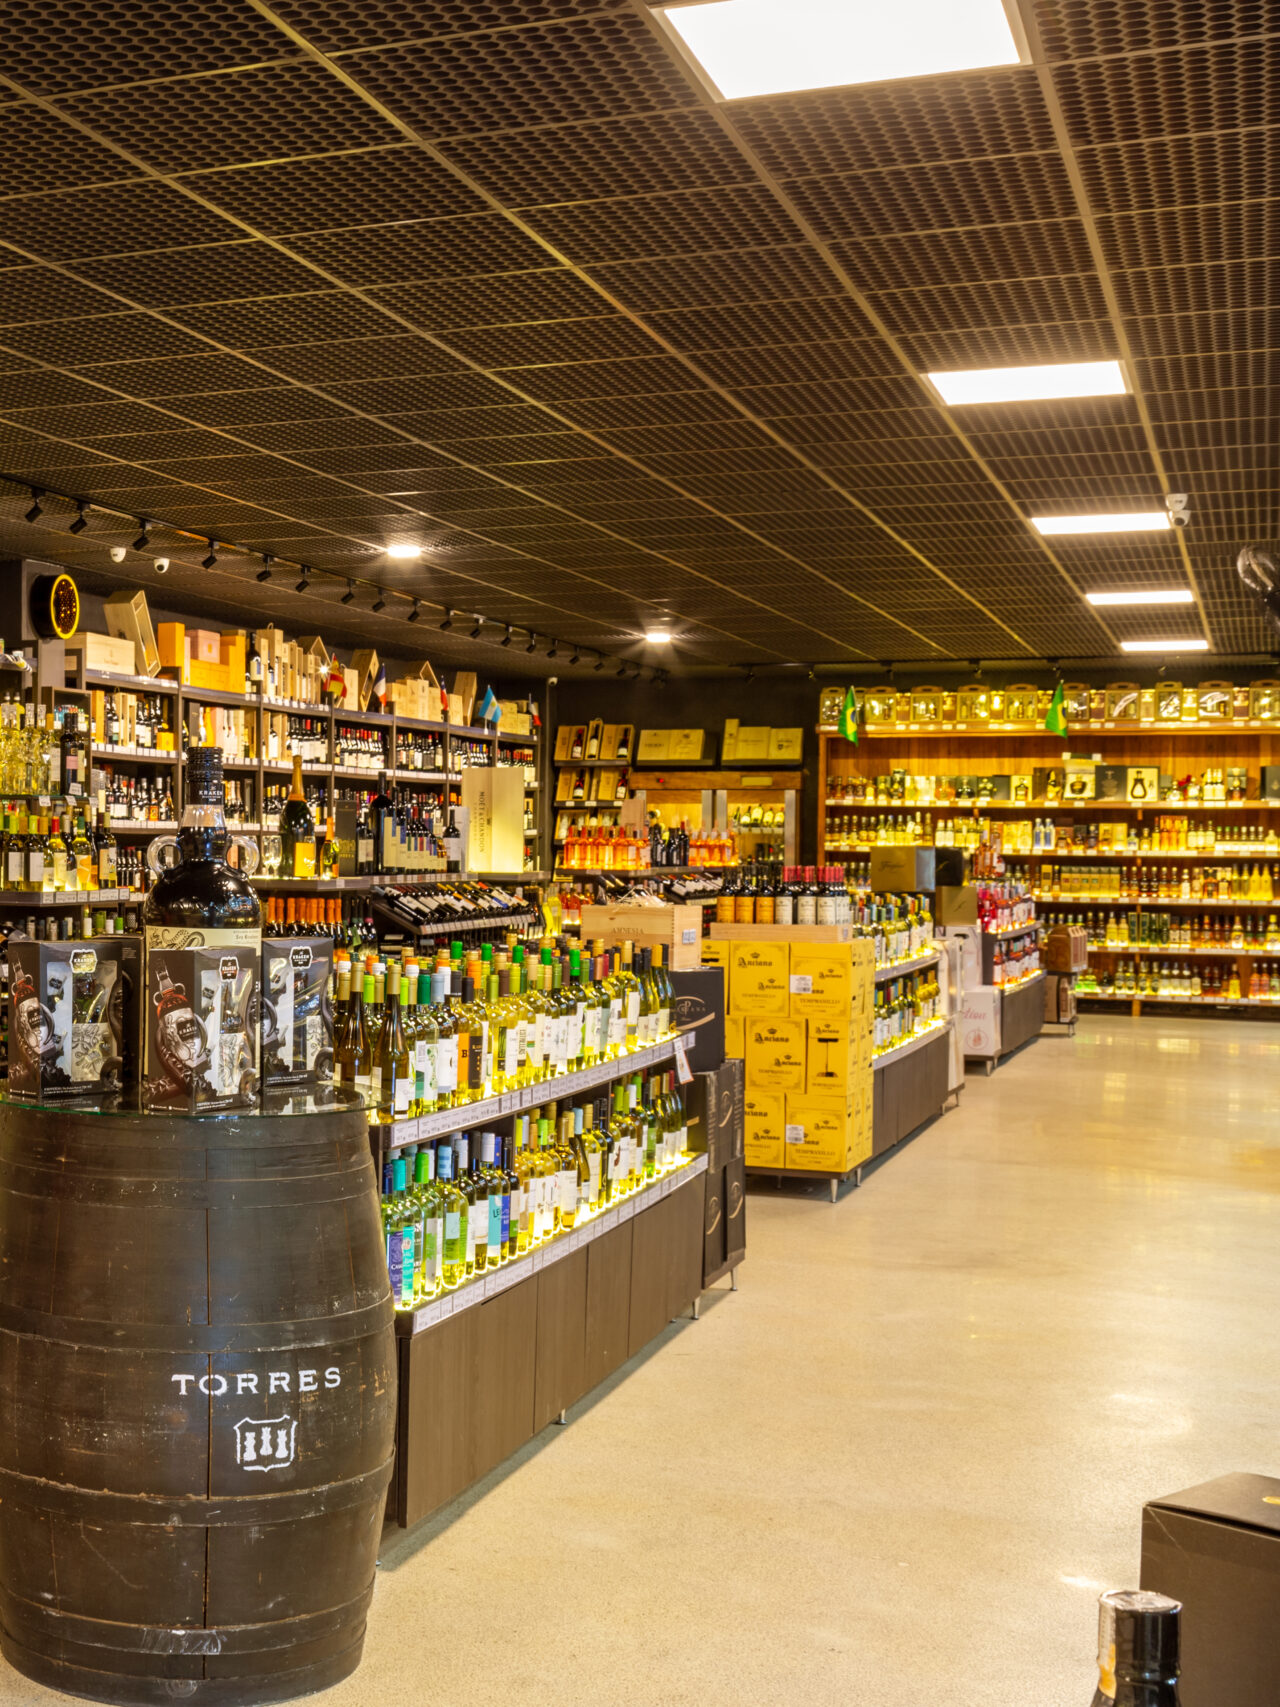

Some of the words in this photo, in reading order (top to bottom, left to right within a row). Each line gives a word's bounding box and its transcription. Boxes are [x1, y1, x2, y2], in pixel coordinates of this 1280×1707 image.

[737, 957, 773, 968] Anciano
[758, 982, 785, 991] Anciano
[754, 1032, 789, 1044] Anciano
[774, 1058, 802, 1067] Anciano
[753, 1132, 780, 1141] Anciano
[171, 1366, 342, 1396] TORRES
